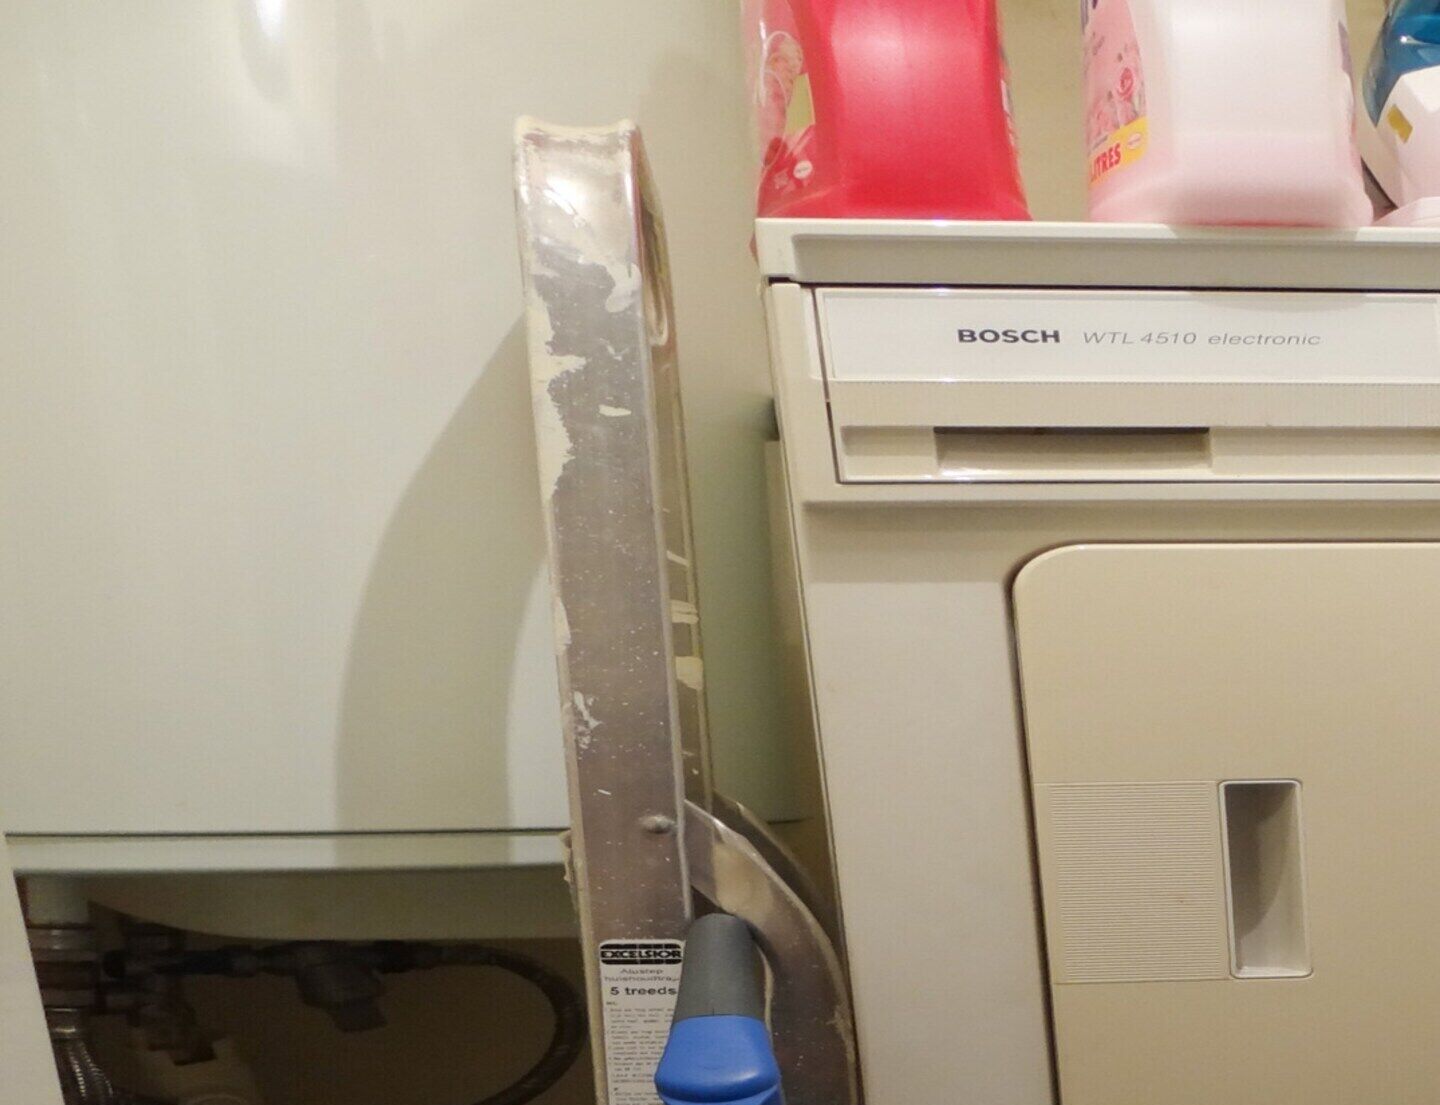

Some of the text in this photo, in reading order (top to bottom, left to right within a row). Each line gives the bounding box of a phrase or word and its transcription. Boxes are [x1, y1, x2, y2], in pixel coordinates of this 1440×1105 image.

[957, 328, 1321, 346] BOSCH WTL 4510 electronic
[600, 950, 682, 959] EXCELSIOR
[610, 986, 677, 996] 5 treeds
